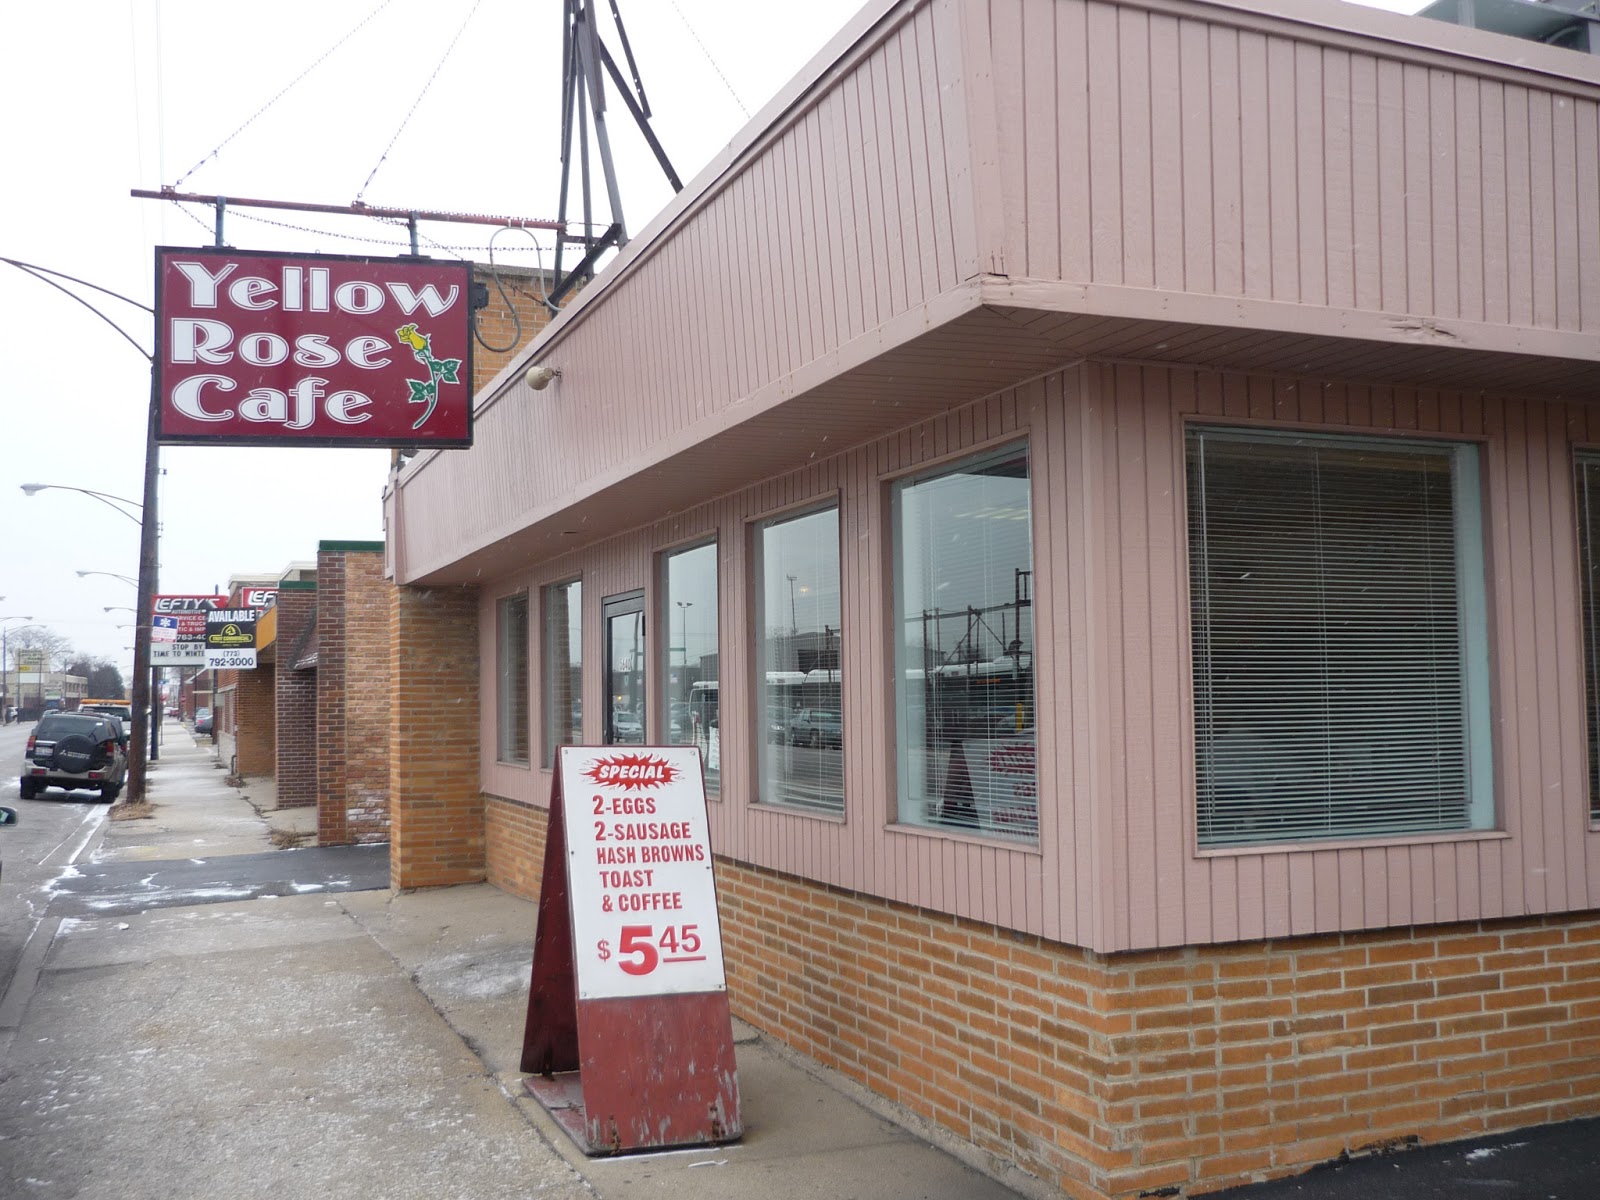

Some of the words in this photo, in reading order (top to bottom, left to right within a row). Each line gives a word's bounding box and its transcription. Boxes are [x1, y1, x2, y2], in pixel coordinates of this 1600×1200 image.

[171, 261, 460, 318] Yellow
[171, 317, 392, 370] Rose
[171, 374, 373, 430] Cafe
[208, 610, 255, 622] AVAILABLE
[210, 658, 254, 666] 792-3000
[598, 765, 665, 779] SPECIAL
[593, 795, 656, 815] 2-EGGS
[594, 821, 691, 841] 2-SAUSAGE
[597, 847, 636, 864] HASH
[642, 844, 705, 863] BROWNS
[599, 870, 653, 888] TOAST
[602, 895, 613, 912] &
[619, 892, 682, 912] COFFEE
